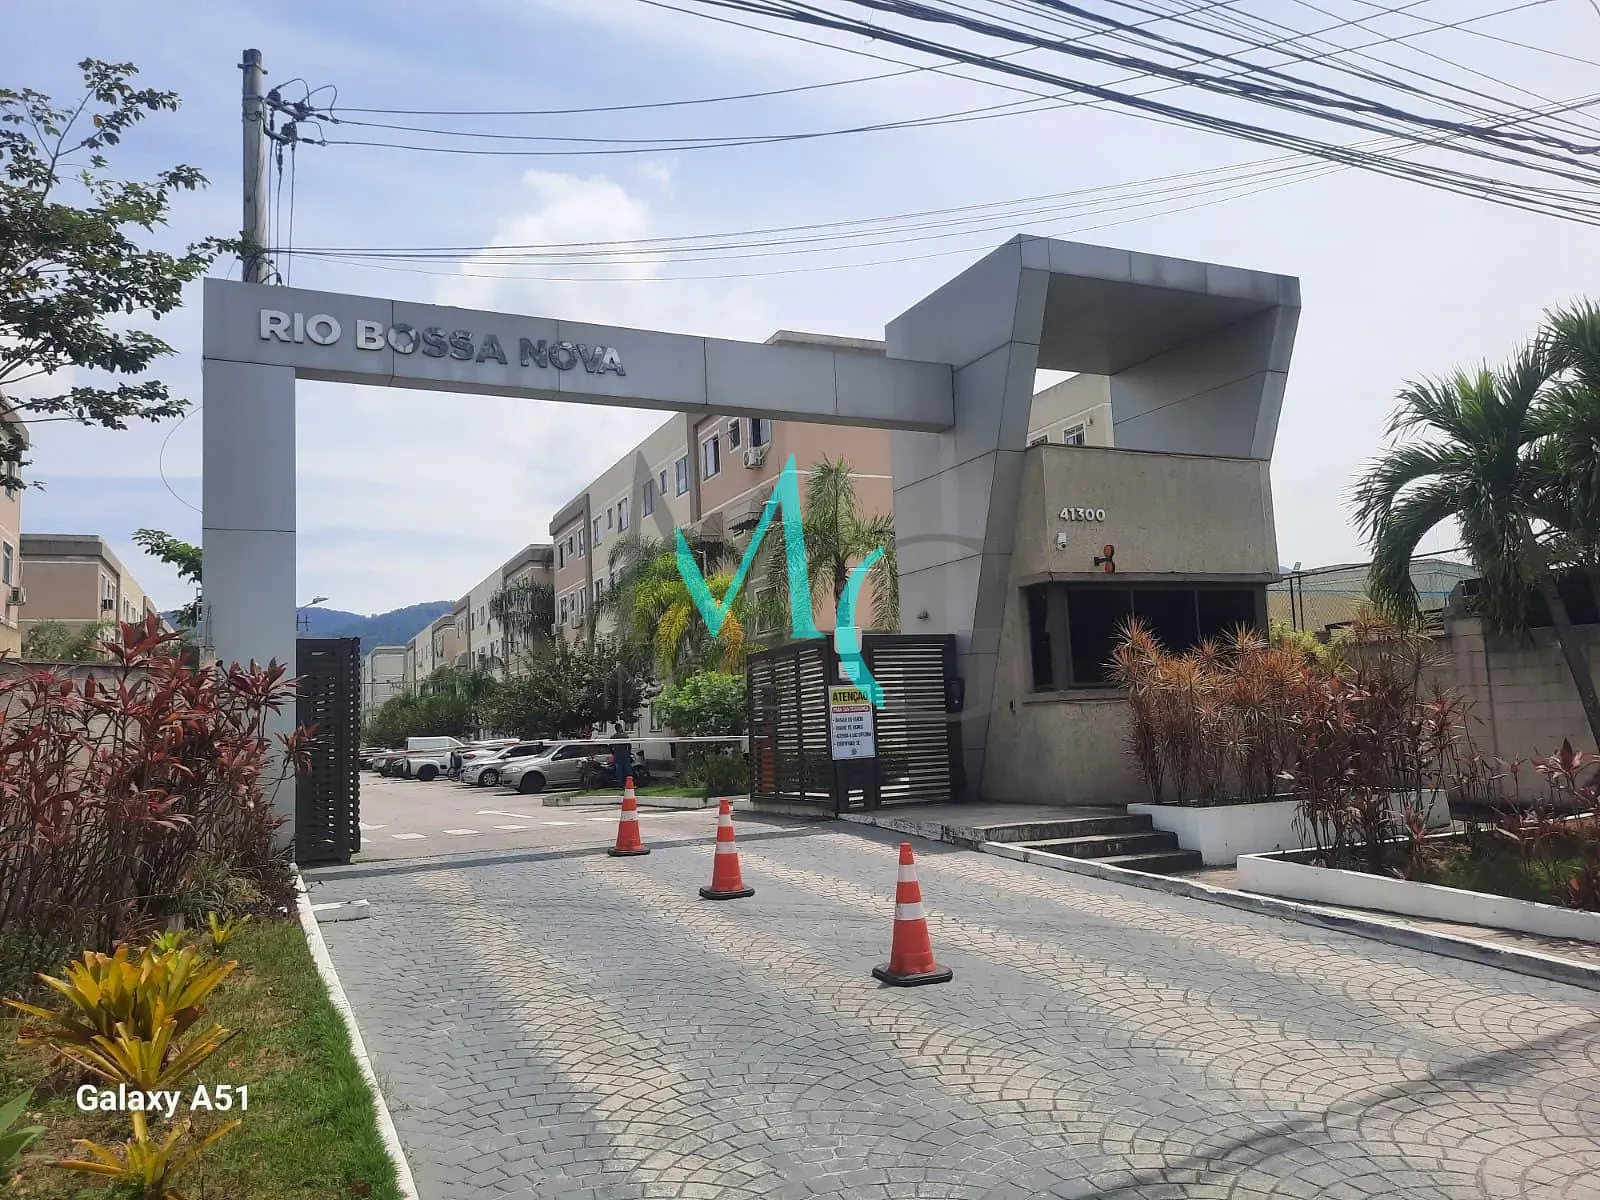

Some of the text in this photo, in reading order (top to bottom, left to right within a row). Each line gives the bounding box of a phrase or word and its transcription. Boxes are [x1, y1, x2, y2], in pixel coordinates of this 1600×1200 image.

[259, 308, 626, 376] RIO BOSSA NOVA
[1059, 506, 1106, 522] 41300
